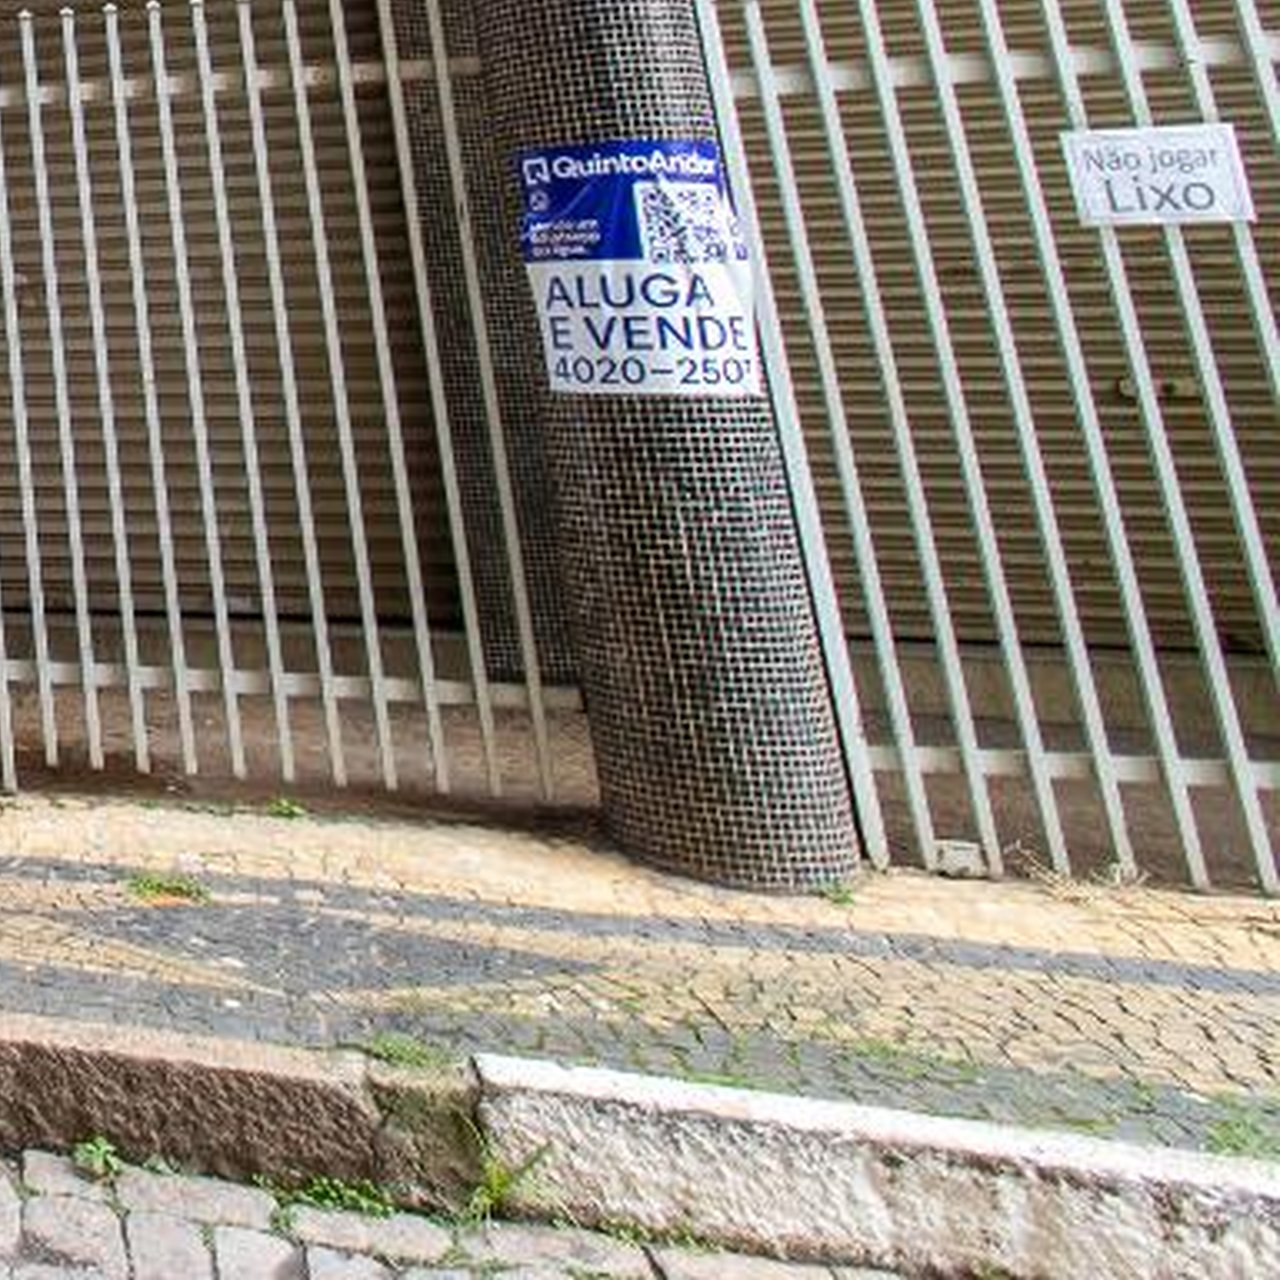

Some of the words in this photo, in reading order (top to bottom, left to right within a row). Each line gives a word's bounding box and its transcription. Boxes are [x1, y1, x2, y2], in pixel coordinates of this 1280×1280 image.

[1083, 144, 1140, 172] Não
[1146, 145, 1217, 174] jogar
[1104, 174, 1215, 213] Lixo
[545, 273, 715, 310] ALUGA
[549, 317, 574, 351] E
[583, 315, 748, 351] VENDE
